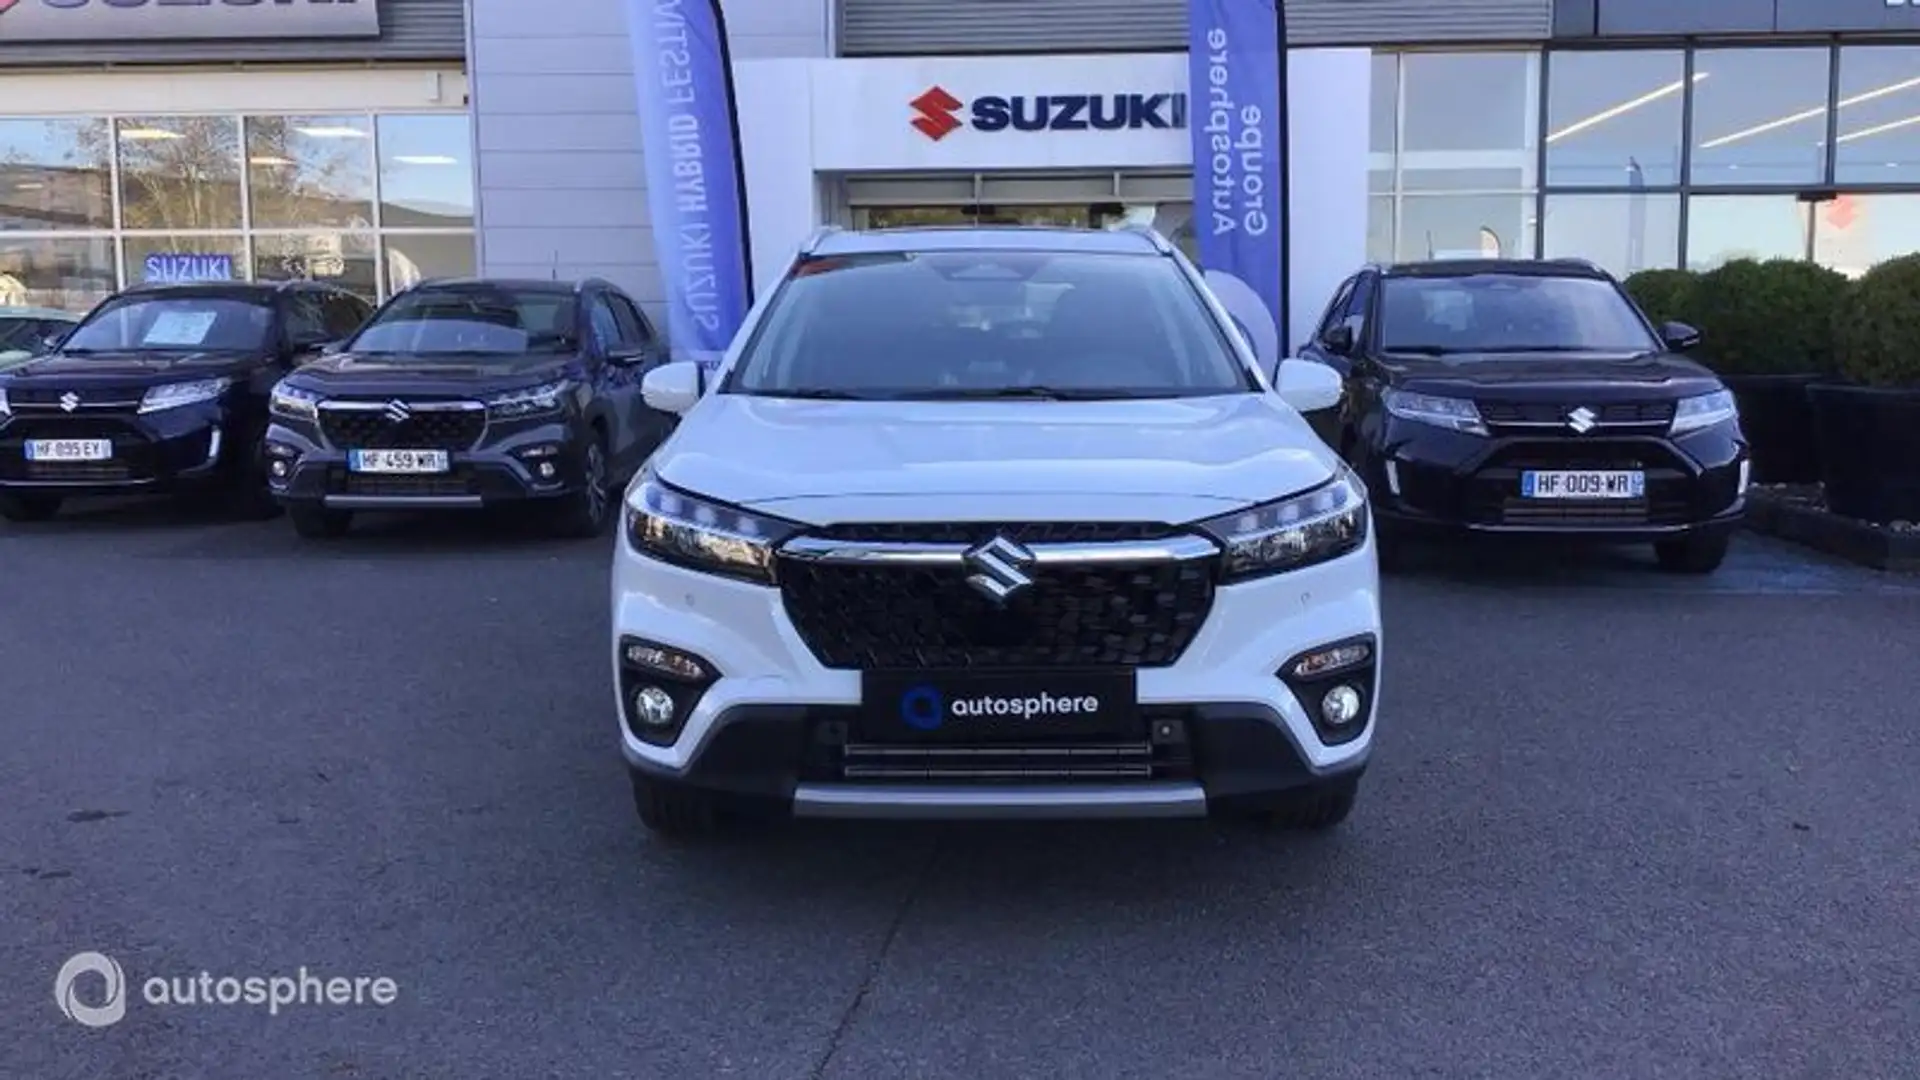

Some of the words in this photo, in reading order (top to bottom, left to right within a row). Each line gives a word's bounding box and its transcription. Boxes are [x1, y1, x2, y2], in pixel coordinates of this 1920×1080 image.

[971, 93, 1188, 132] SUZUKI
[146, 256, 231, 282] SUZUKI
[951, 691, 1099, 720] autosphere
